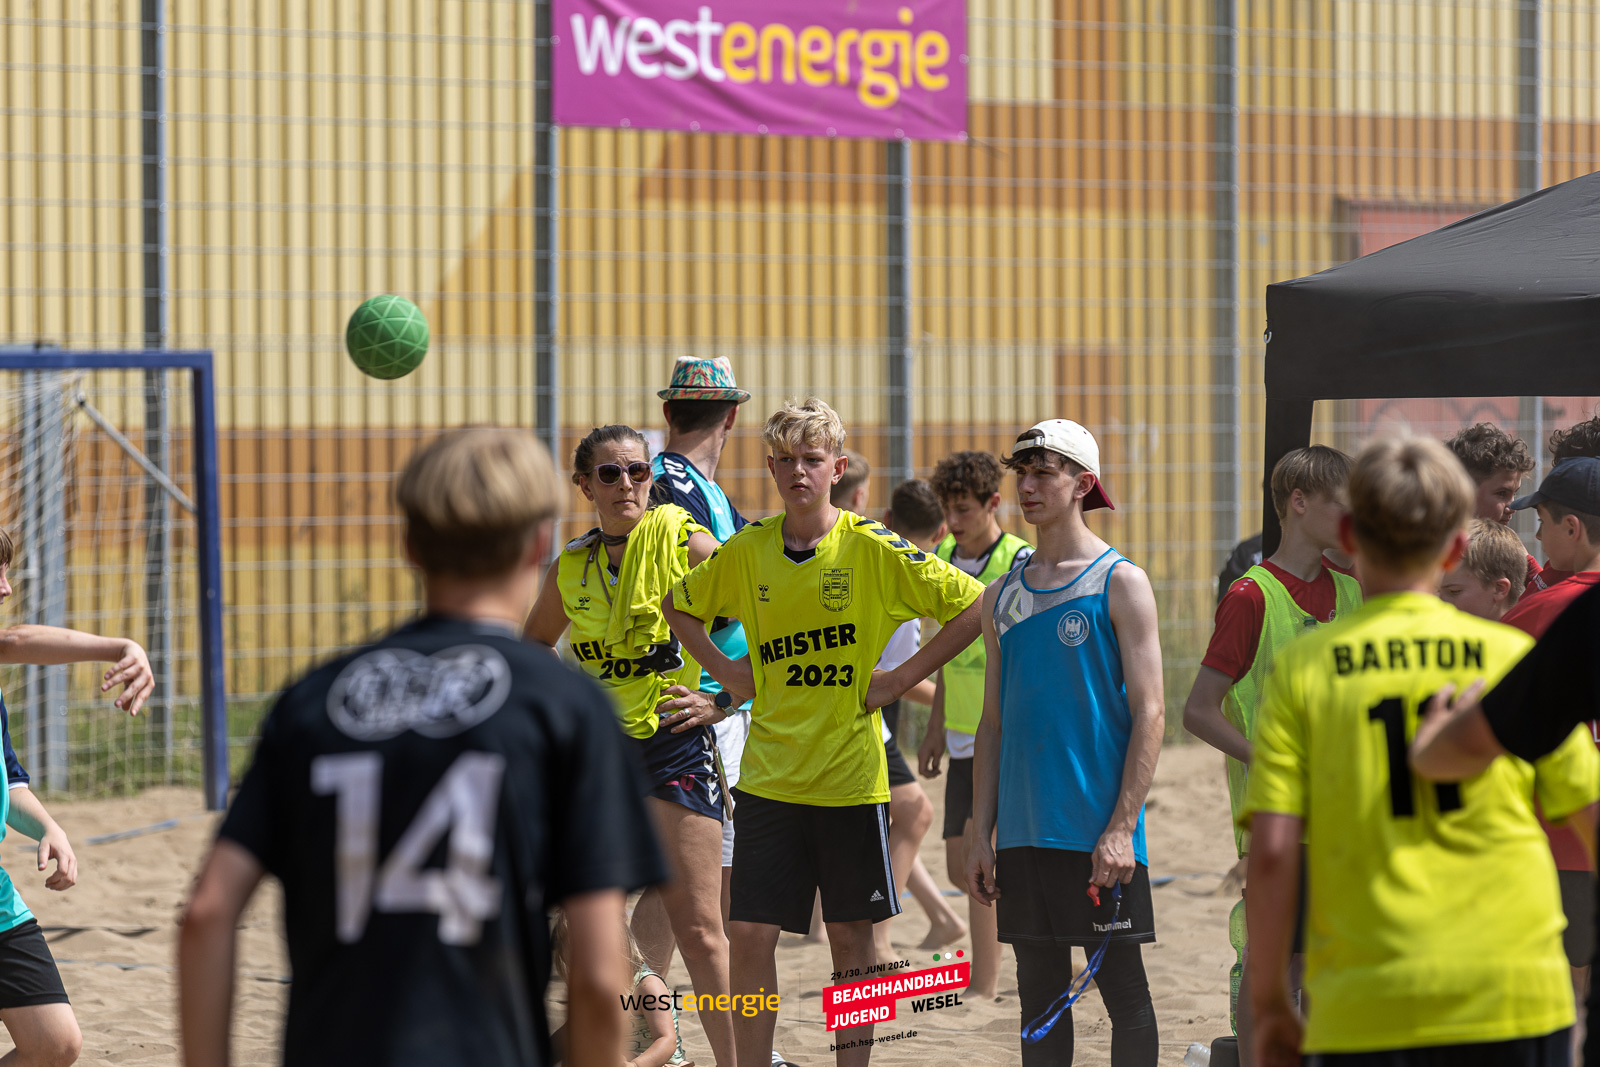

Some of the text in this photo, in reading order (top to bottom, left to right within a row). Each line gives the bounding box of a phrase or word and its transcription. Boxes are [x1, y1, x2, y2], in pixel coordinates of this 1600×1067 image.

[570, 6, 950, 108] westenergie
[760, 623, 857, 666] MEISTER
[1333, 639, 1484, 675] BARTON
[785, 664, 854, 687] 2023
[310, 751, 506, 945] 14
